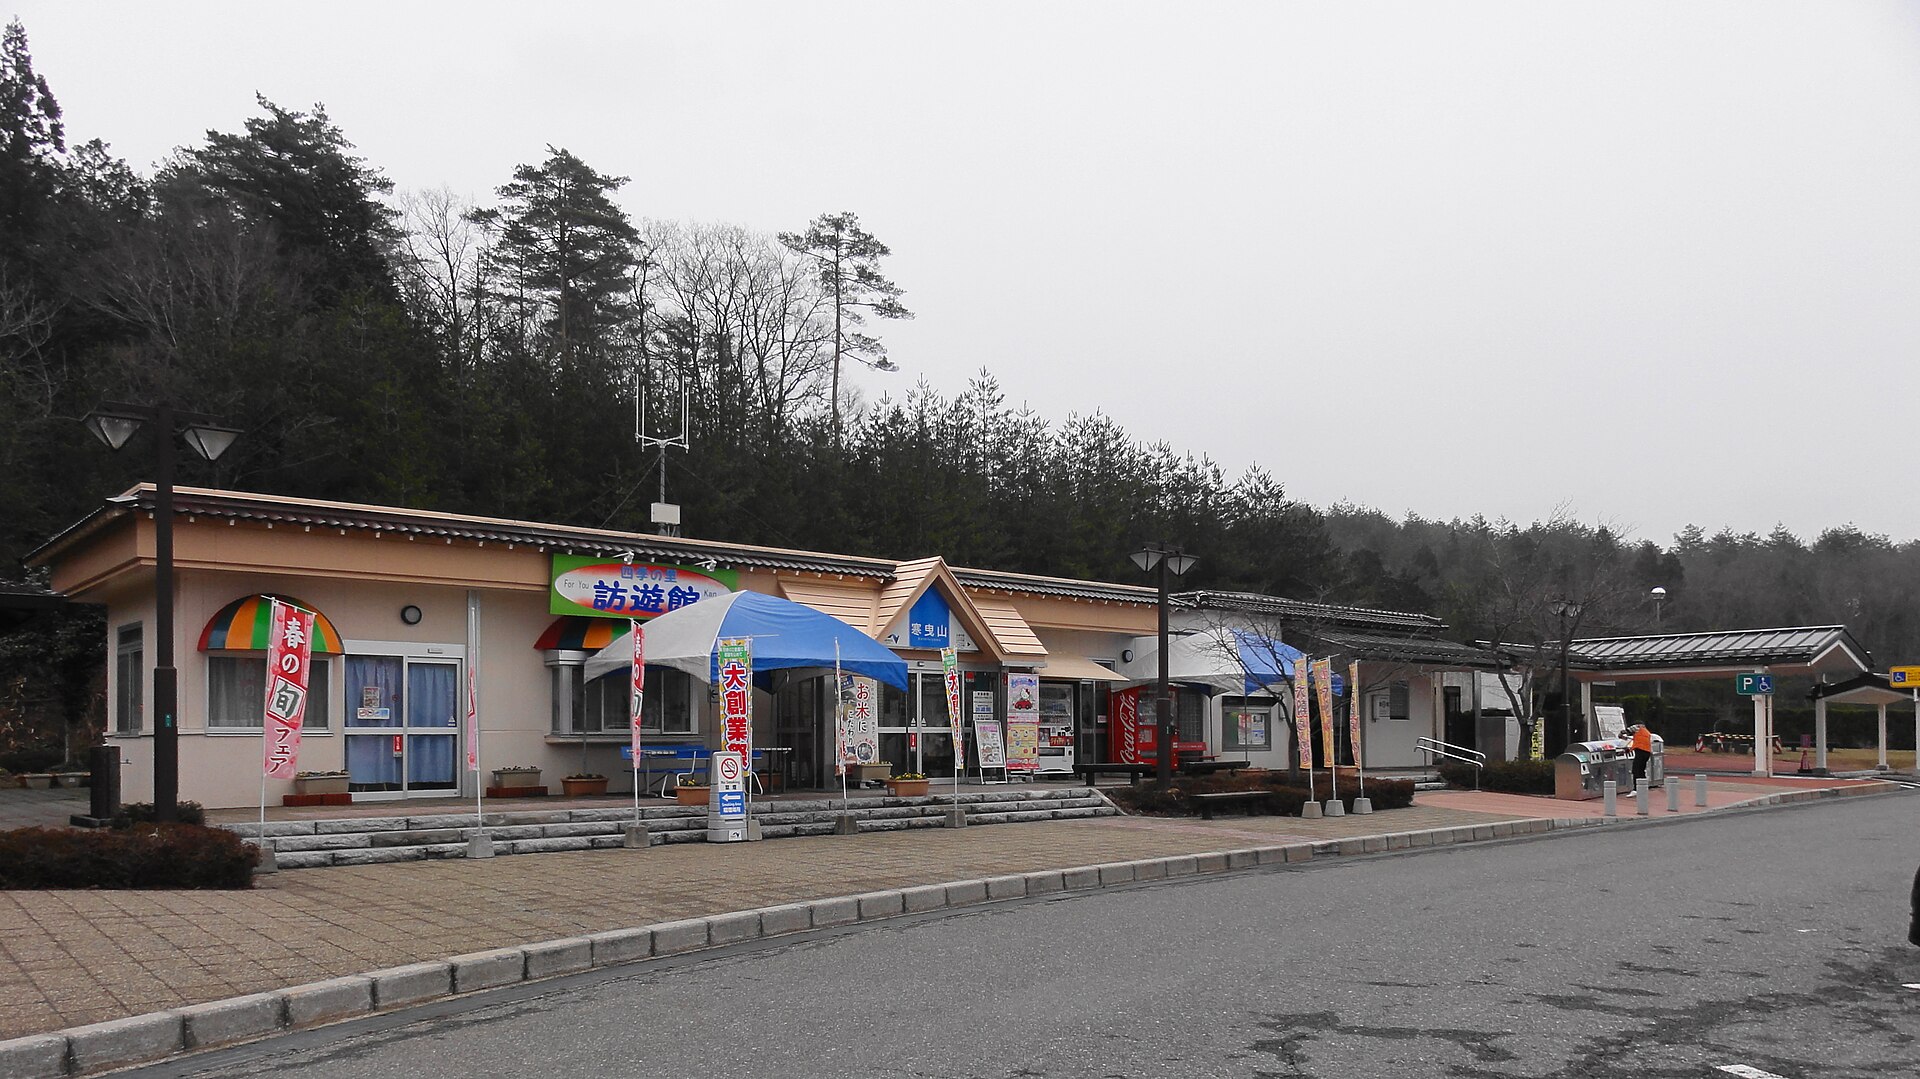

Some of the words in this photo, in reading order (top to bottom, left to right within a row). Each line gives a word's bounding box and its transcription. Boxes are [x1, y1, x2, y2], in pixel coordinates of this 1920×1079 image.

[620, 566, 678, 583] 四季の里
[564, 580, 575, 589] For
[578, 581, 590, 590] You
[592, 579, 700, 614] 訪遊館
[703, 589, 717, 598] Kan
[911, 622, 948, 638] 寒曳山
[1743, 677, 1753, 690] P
[856, 682, 870, 732] お米に
